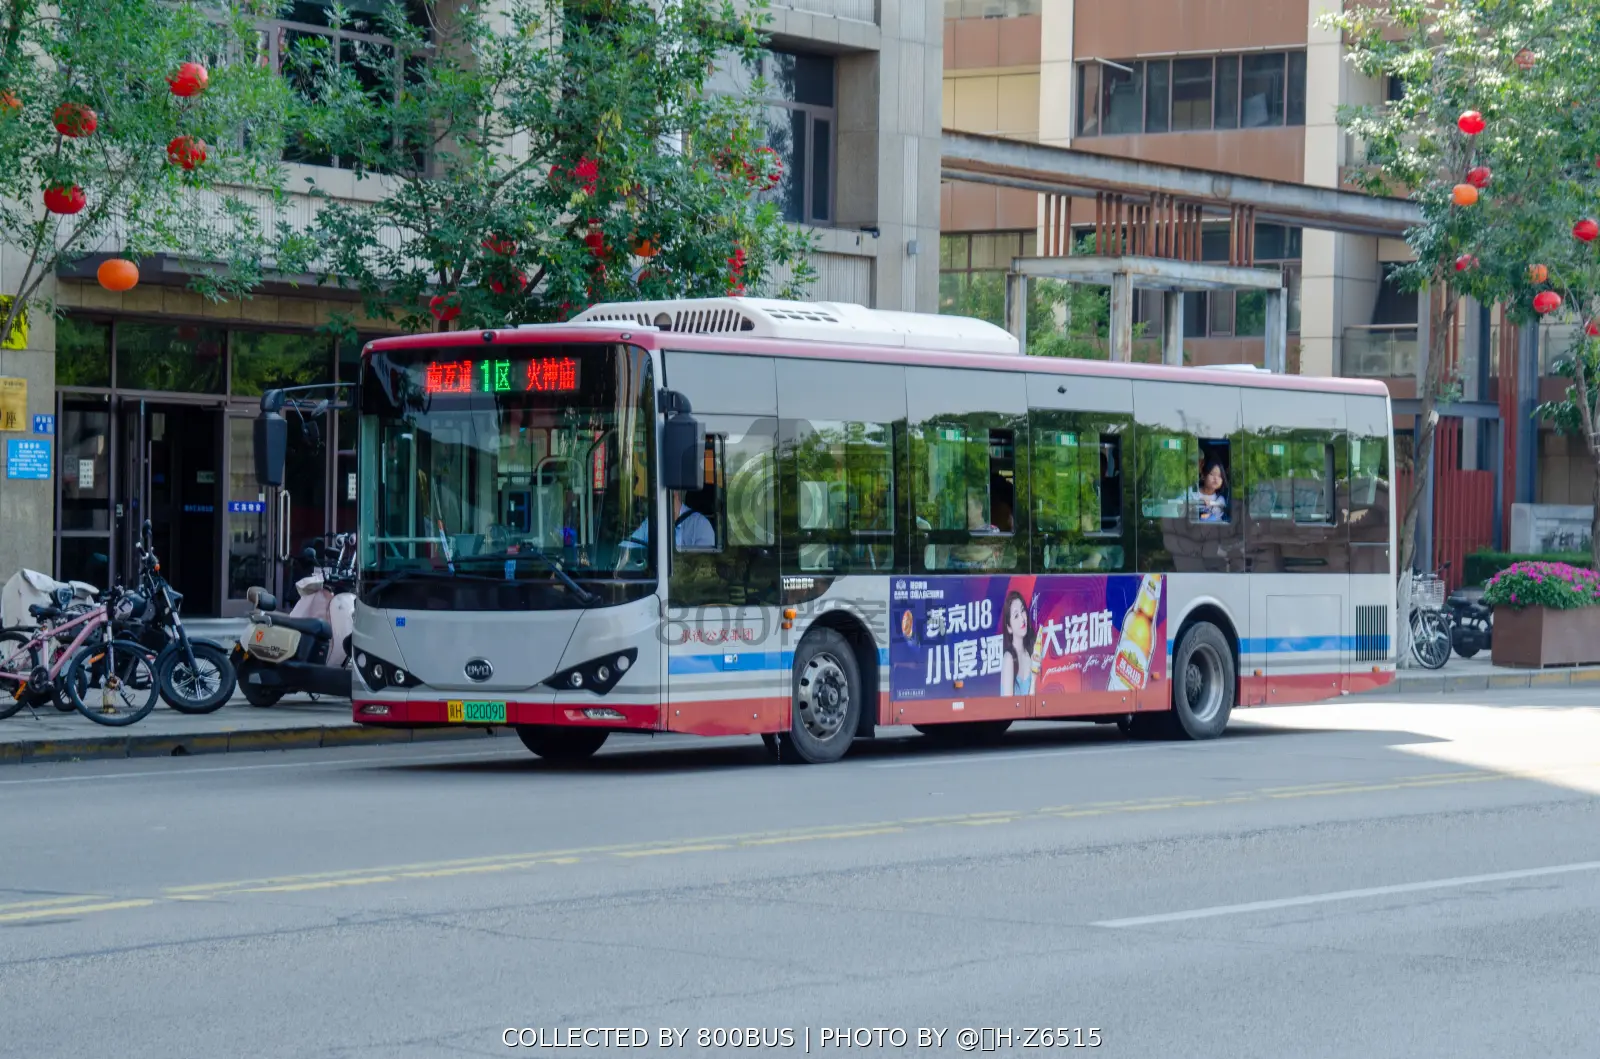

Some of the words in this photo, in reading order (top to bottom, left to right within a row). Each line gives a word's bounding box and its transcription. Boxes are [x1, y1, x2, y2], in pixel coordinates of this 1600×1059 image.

[526, 357, 576, 391] 火神庙
[926, 598, 993, 638] 燕京U8
[1040, 608, 1113, 660] 大滋味
[467, 664, 490, 676] BYD
[925, 634, 1004, 685] 小度酒
[1041, 660, 1083, 684] passion
[1100, 654, 1116, 670] yo
